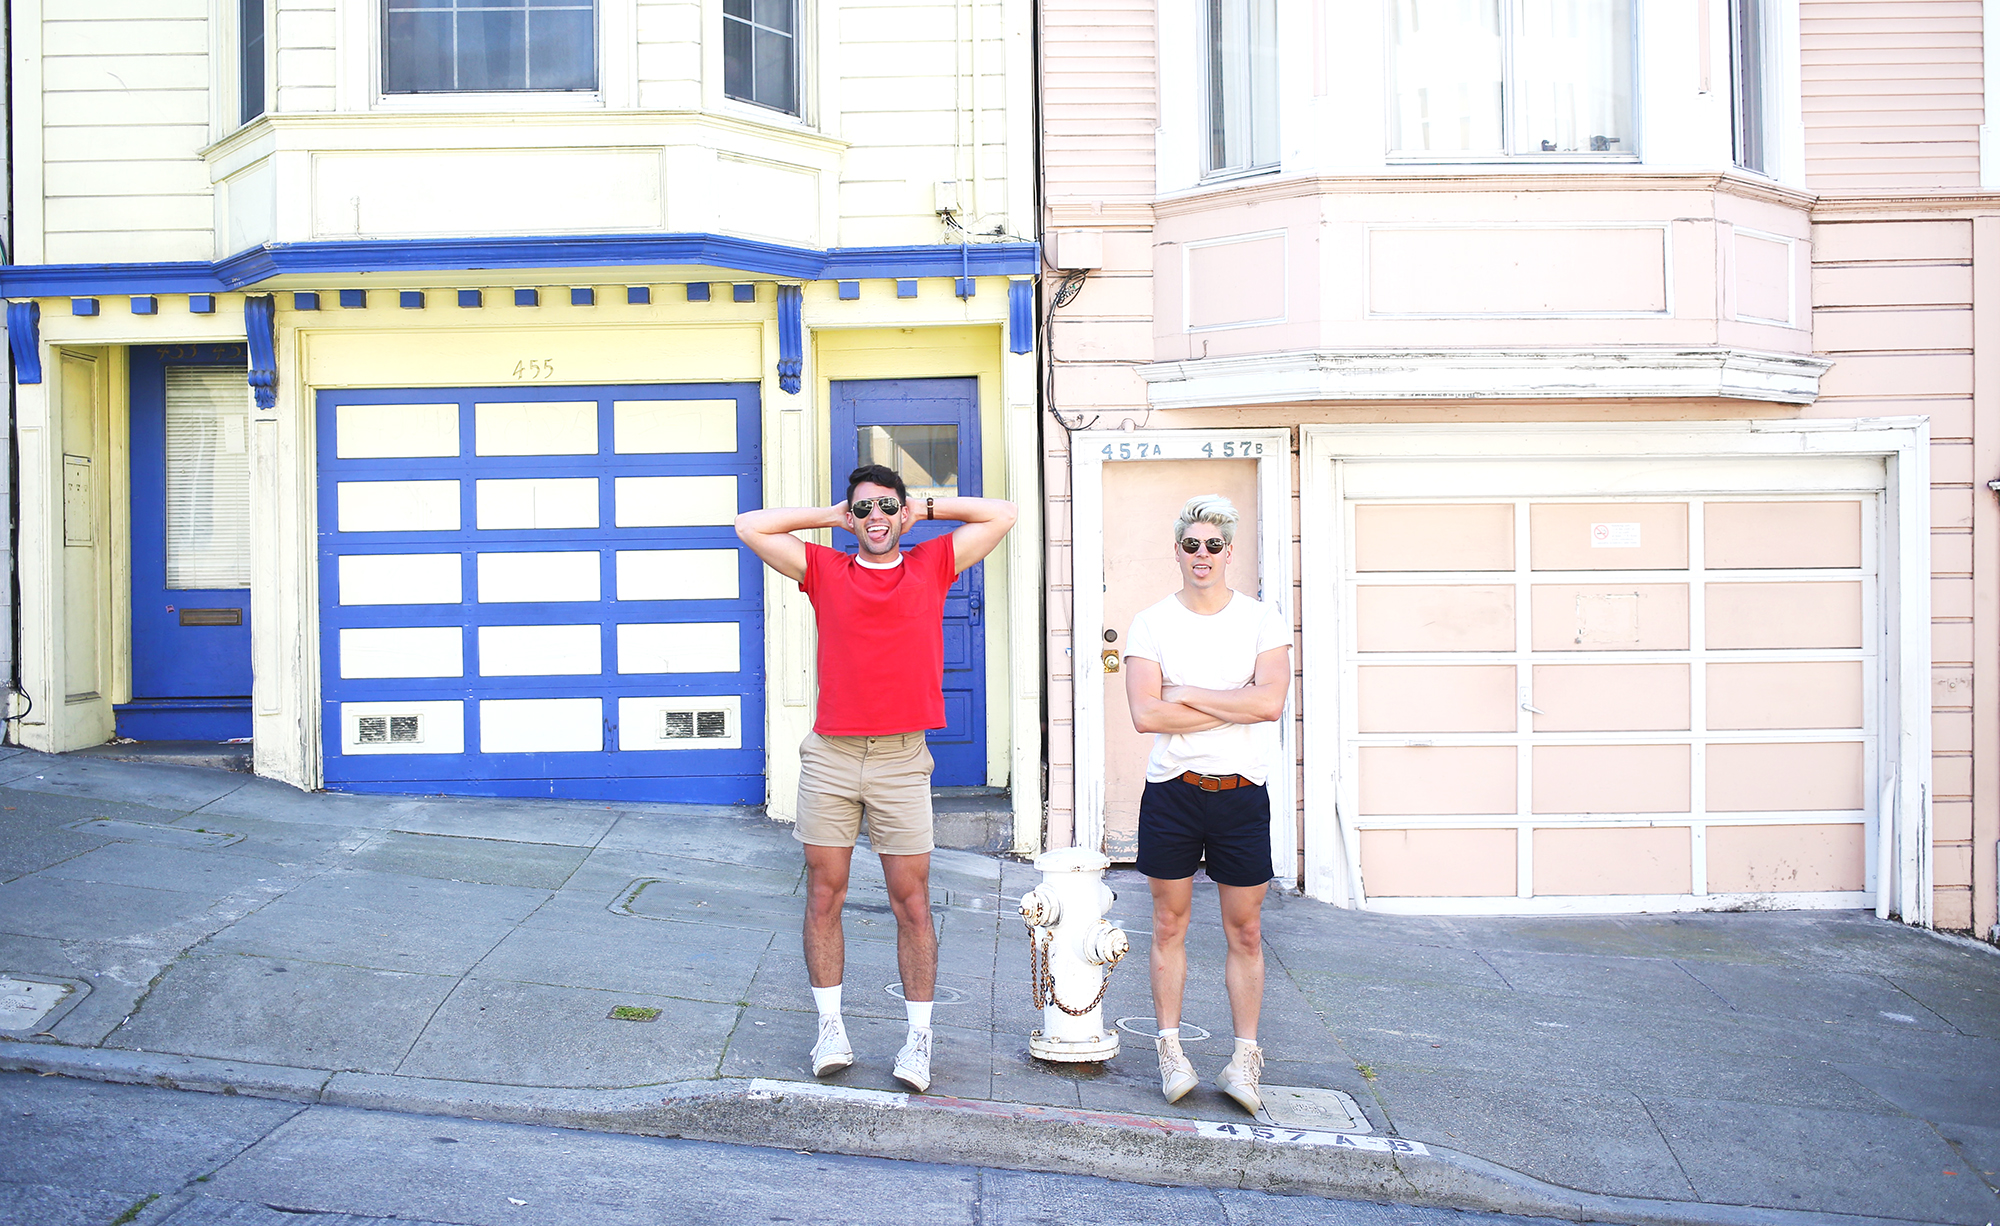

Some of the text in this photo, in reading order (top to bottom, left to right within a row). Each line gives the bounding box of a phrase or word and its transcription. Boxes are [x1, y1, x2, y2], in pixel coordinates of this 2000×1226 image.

[212, 343, 248, 360] 45
[512, 358, 554, 380] 455
[1216, 1124, 1307, 1142] 457
